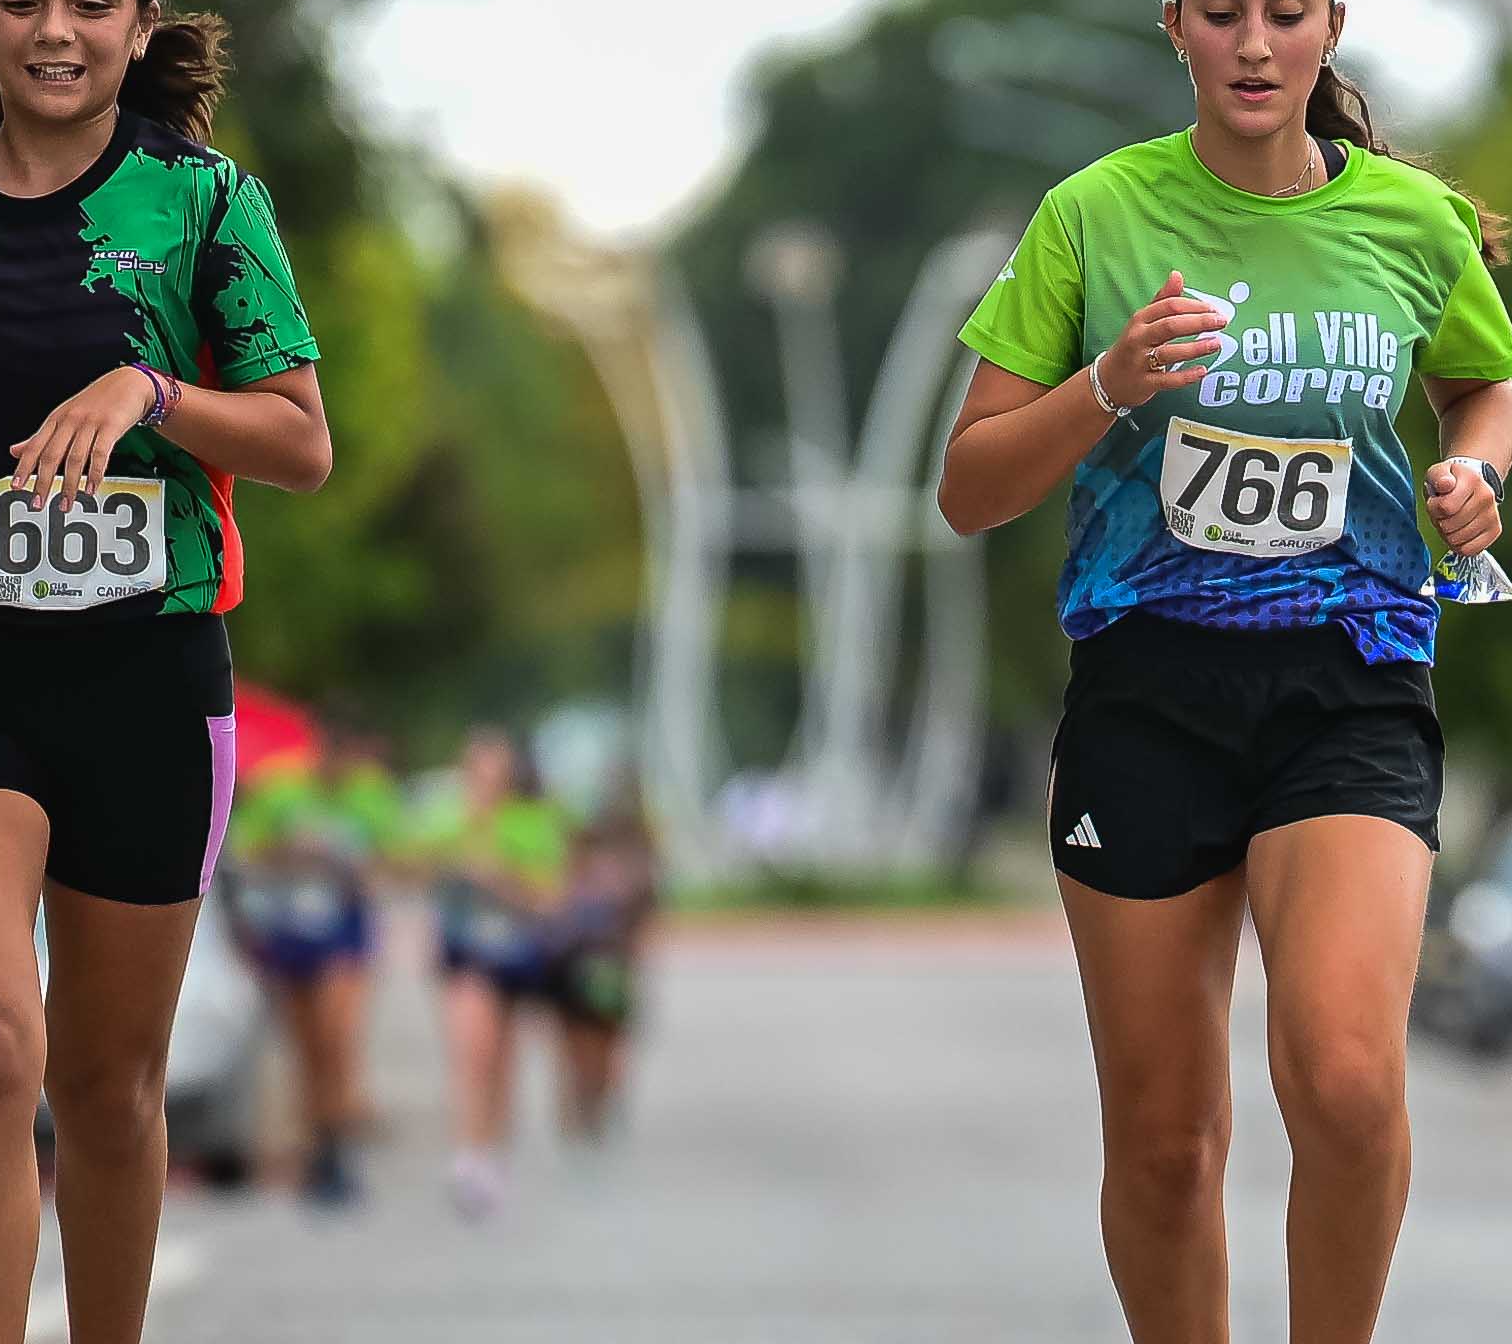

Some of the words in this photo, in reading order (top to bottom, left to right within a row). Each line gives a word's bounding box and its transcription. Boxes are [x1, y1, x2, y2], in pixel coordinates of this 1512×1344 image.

[117, 257, 166, 274] play
[1313, 310, 1399, 373] Ville
[1175, 432, 1334, 532] 766
